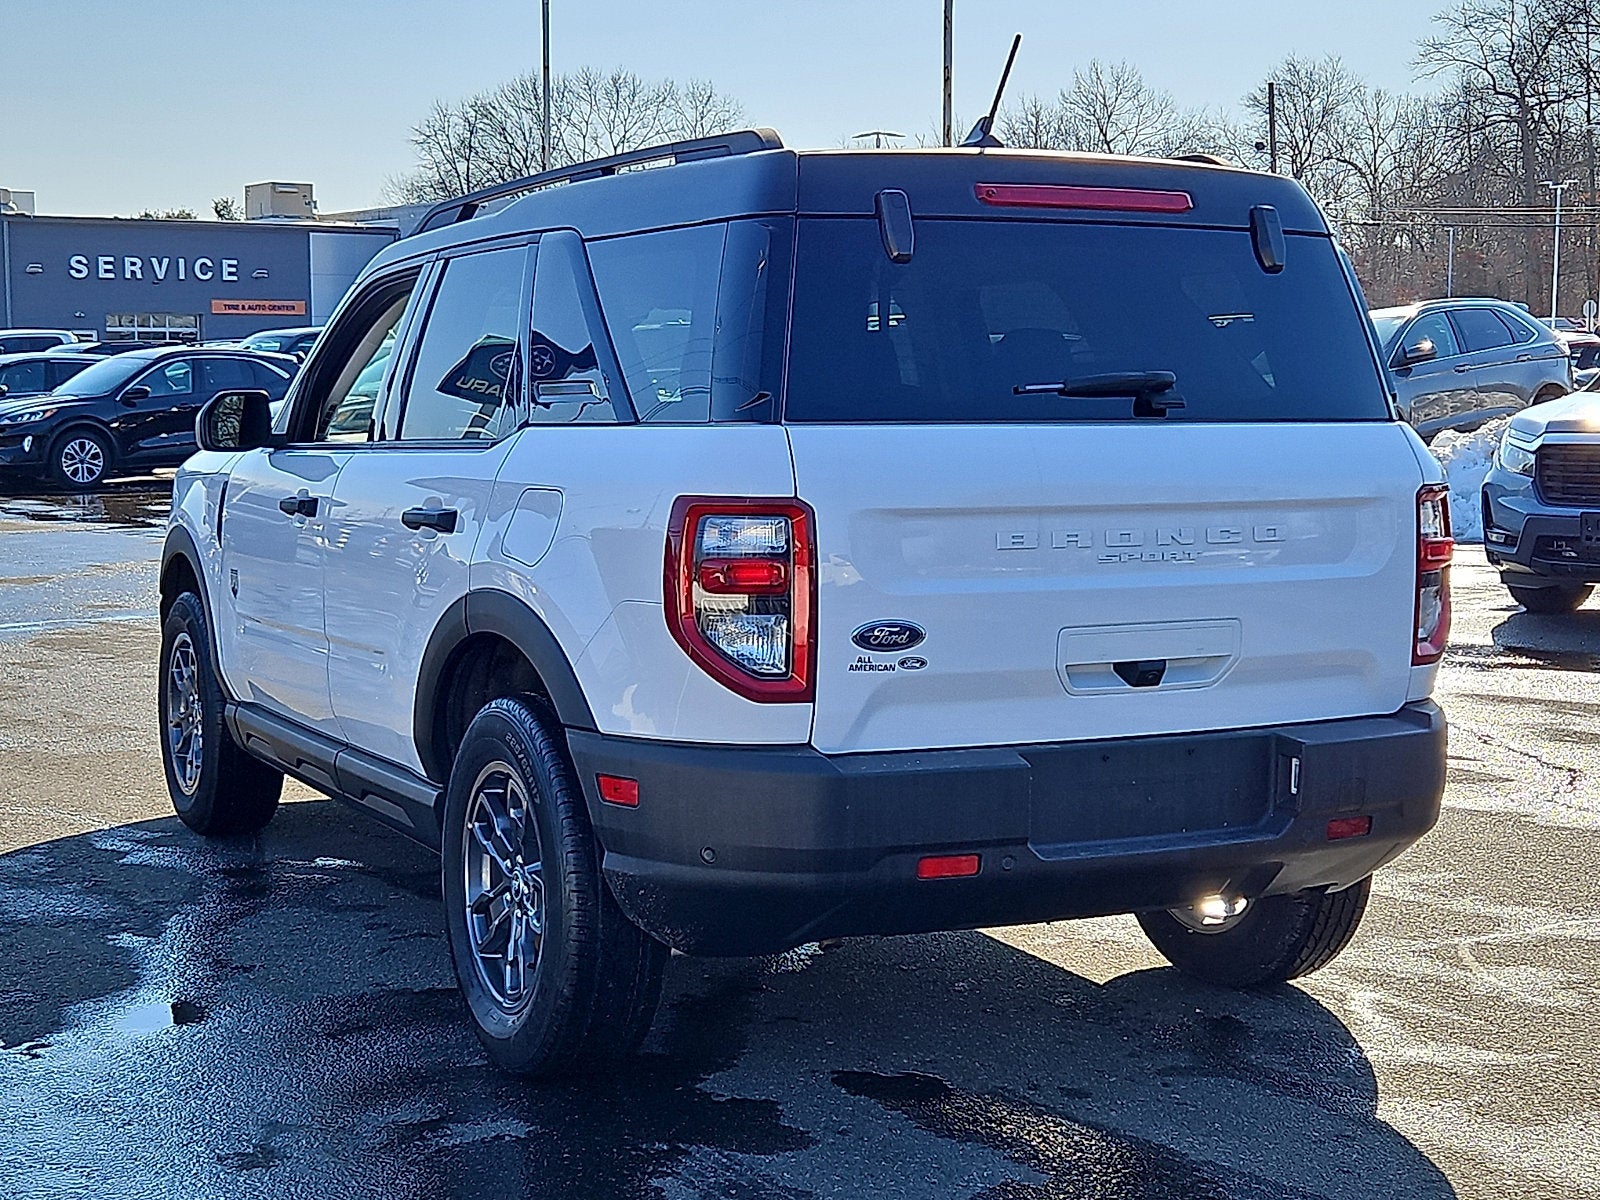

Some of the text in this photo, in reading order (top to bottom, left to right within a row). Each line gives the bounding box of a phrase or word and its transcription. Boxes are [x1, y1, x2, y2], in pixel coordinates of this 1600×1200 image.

[69, 255, 239, 281] SERVICE
[996, 525, 1286, 550] BRONCO
[1097, 550, 1201, 564] SPORT
[864, 627, 909, 644] Ford
[856, 655, 873, 664] ALL
[848, 663, 896, 672] AMERICAN
